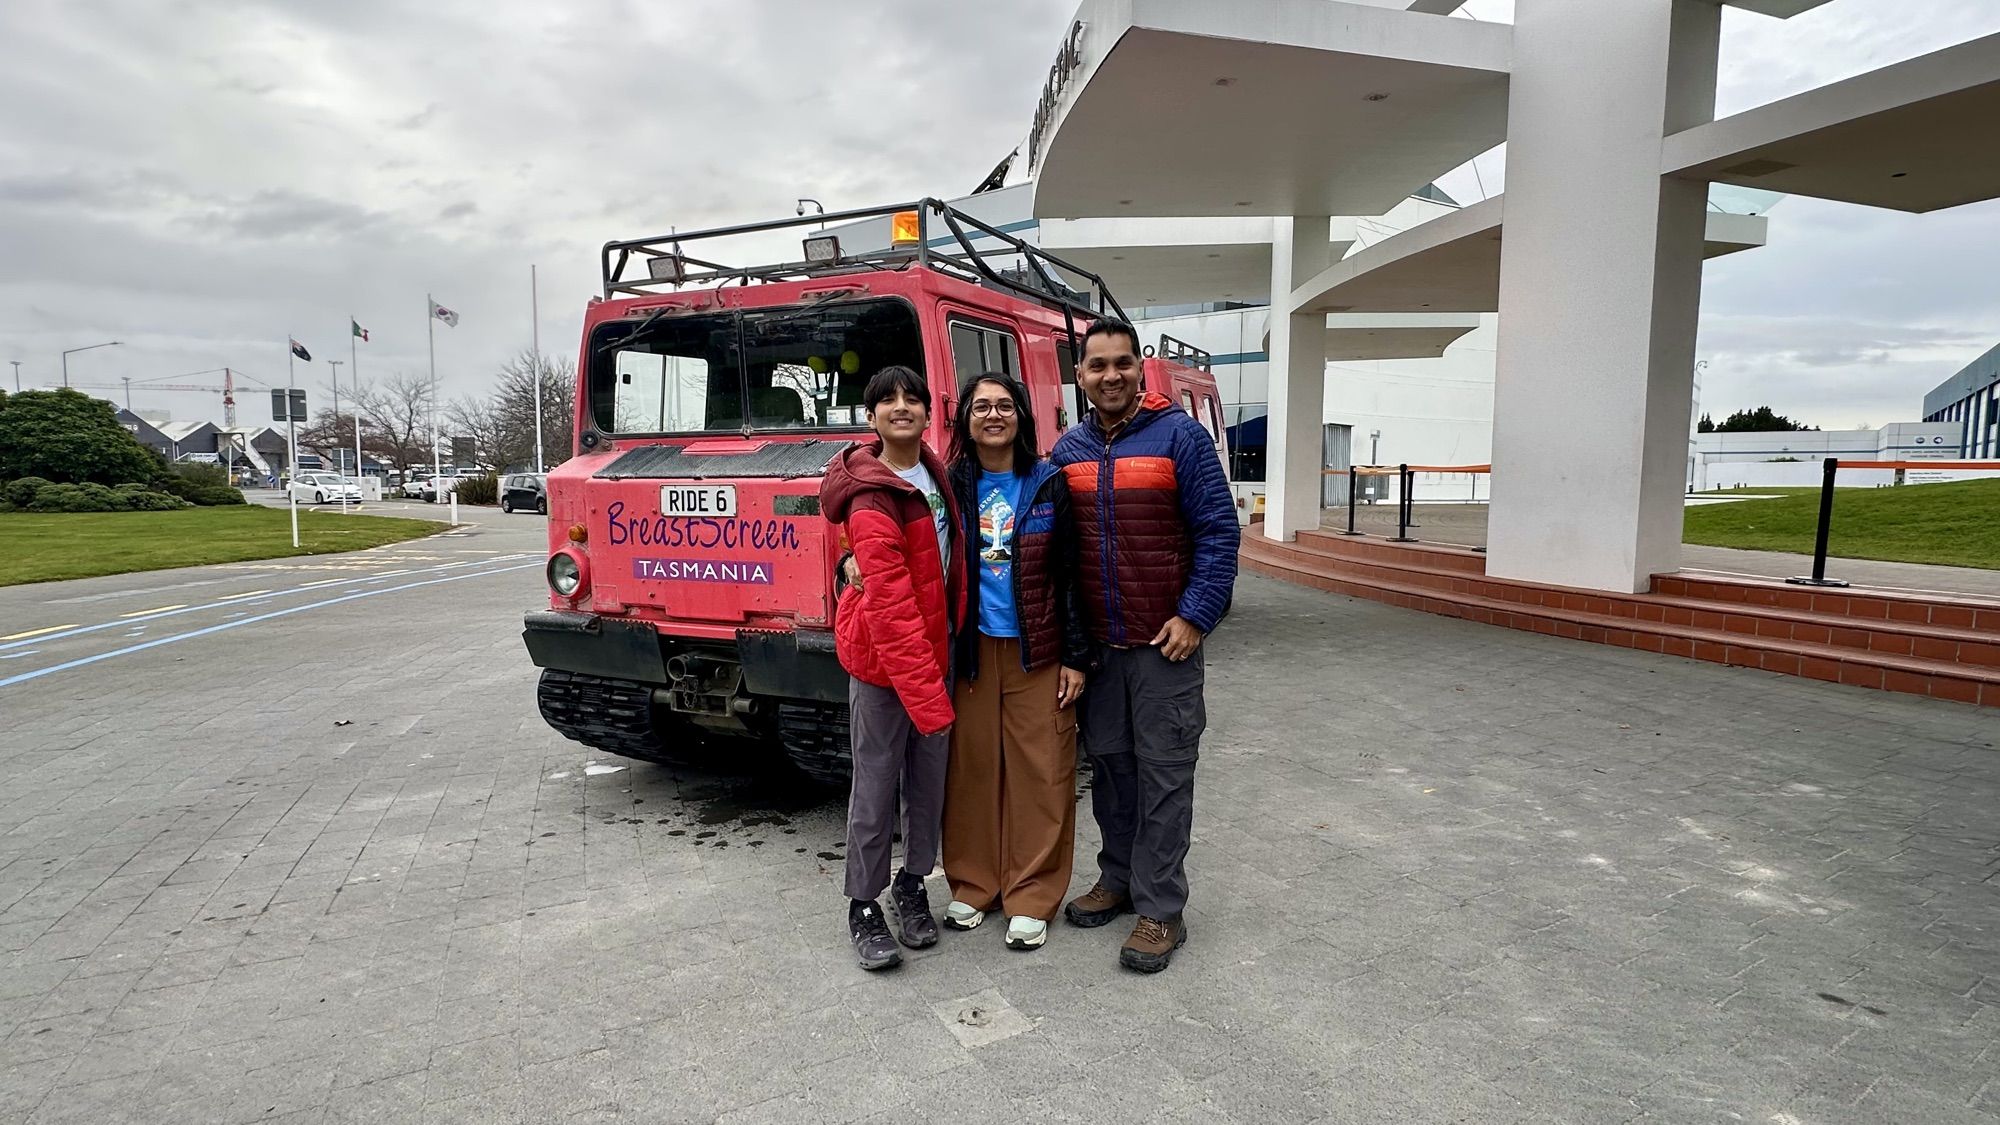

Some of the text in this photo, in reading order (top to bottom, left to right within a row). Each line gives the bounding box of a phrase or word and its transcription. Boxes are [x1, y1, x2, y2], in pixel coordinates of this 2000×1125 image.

[669, 489, 727, 512] RIDE 6
[607, 501, 800, 550] BreastScreen
[638, 559, 769, 583] TASMANIA
